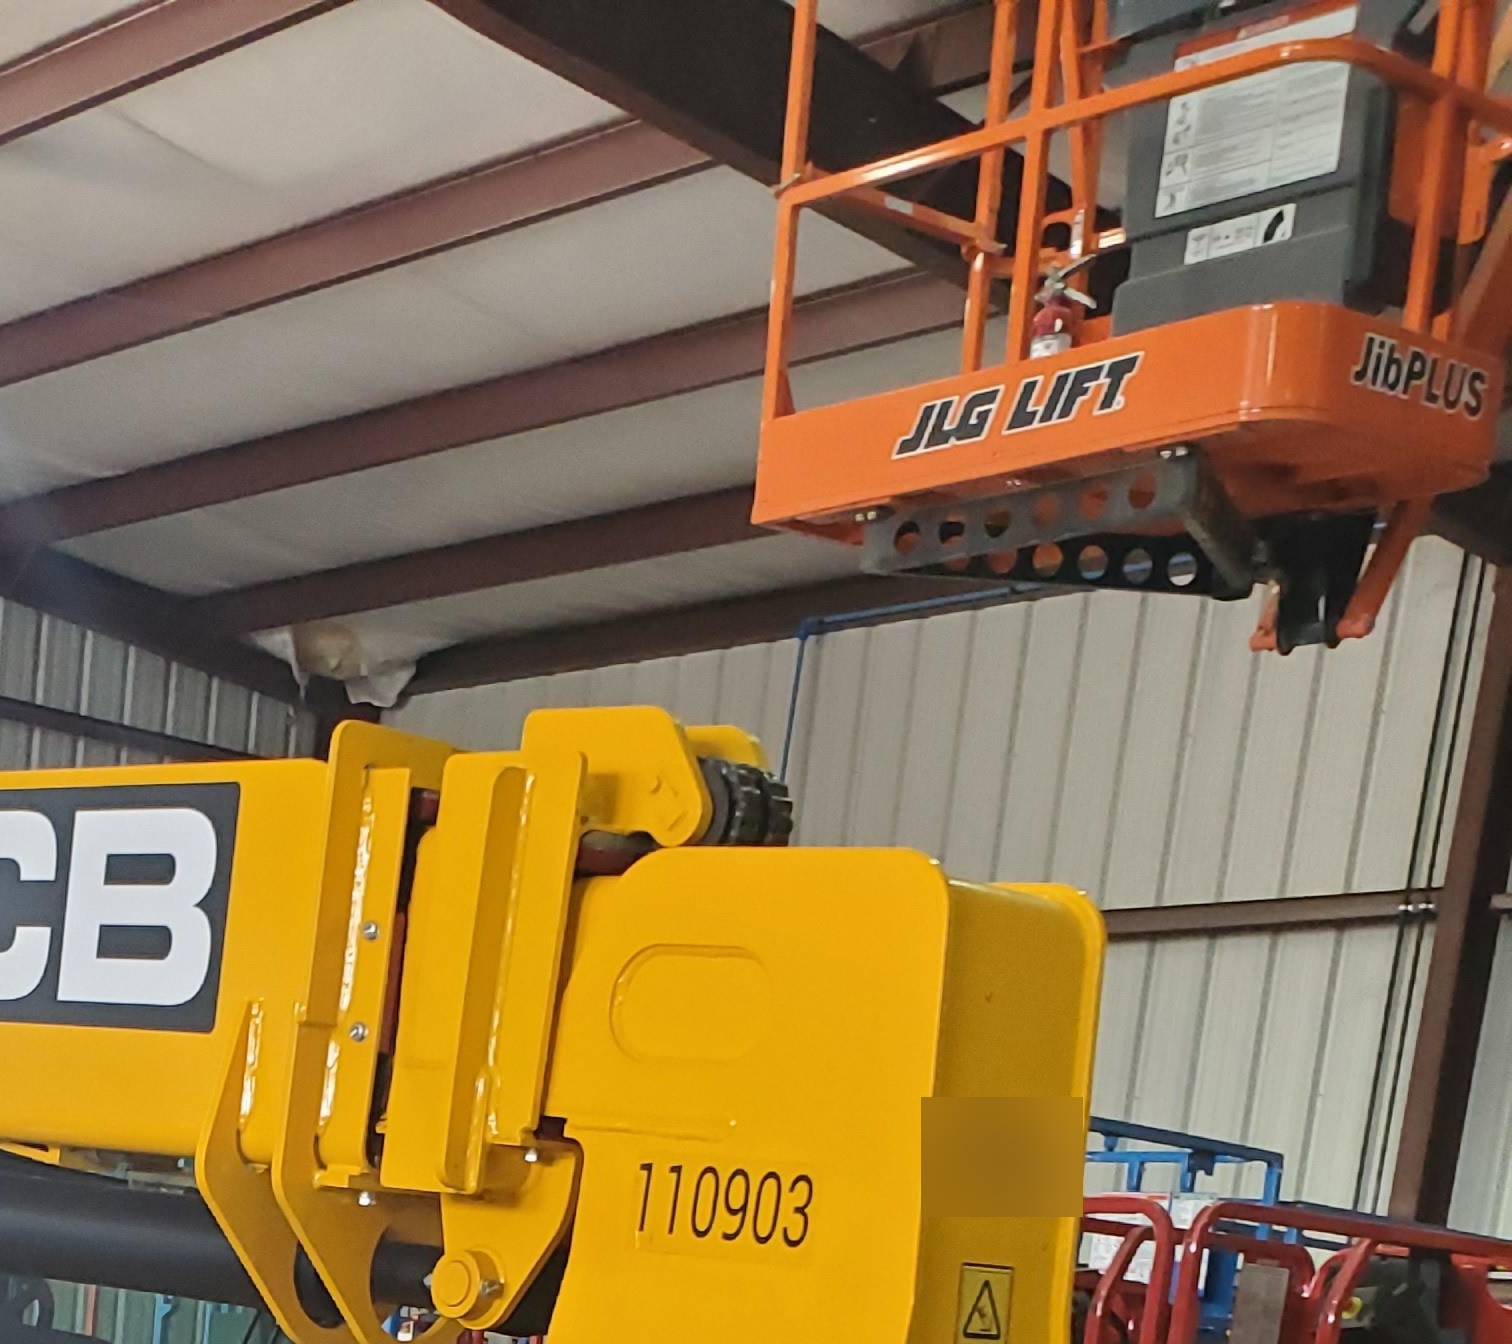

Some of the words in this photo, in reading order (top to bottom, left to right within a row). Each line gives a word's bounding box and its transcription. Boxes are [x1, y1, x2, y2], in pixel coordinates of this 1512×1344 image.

[893, 386, 1003, 457] JLG
[1003, 353, 1142, 433] LIFT
[1353, 335, 1486, 418] JibPLUS
[637, 1162, 814, 1248] 110903
